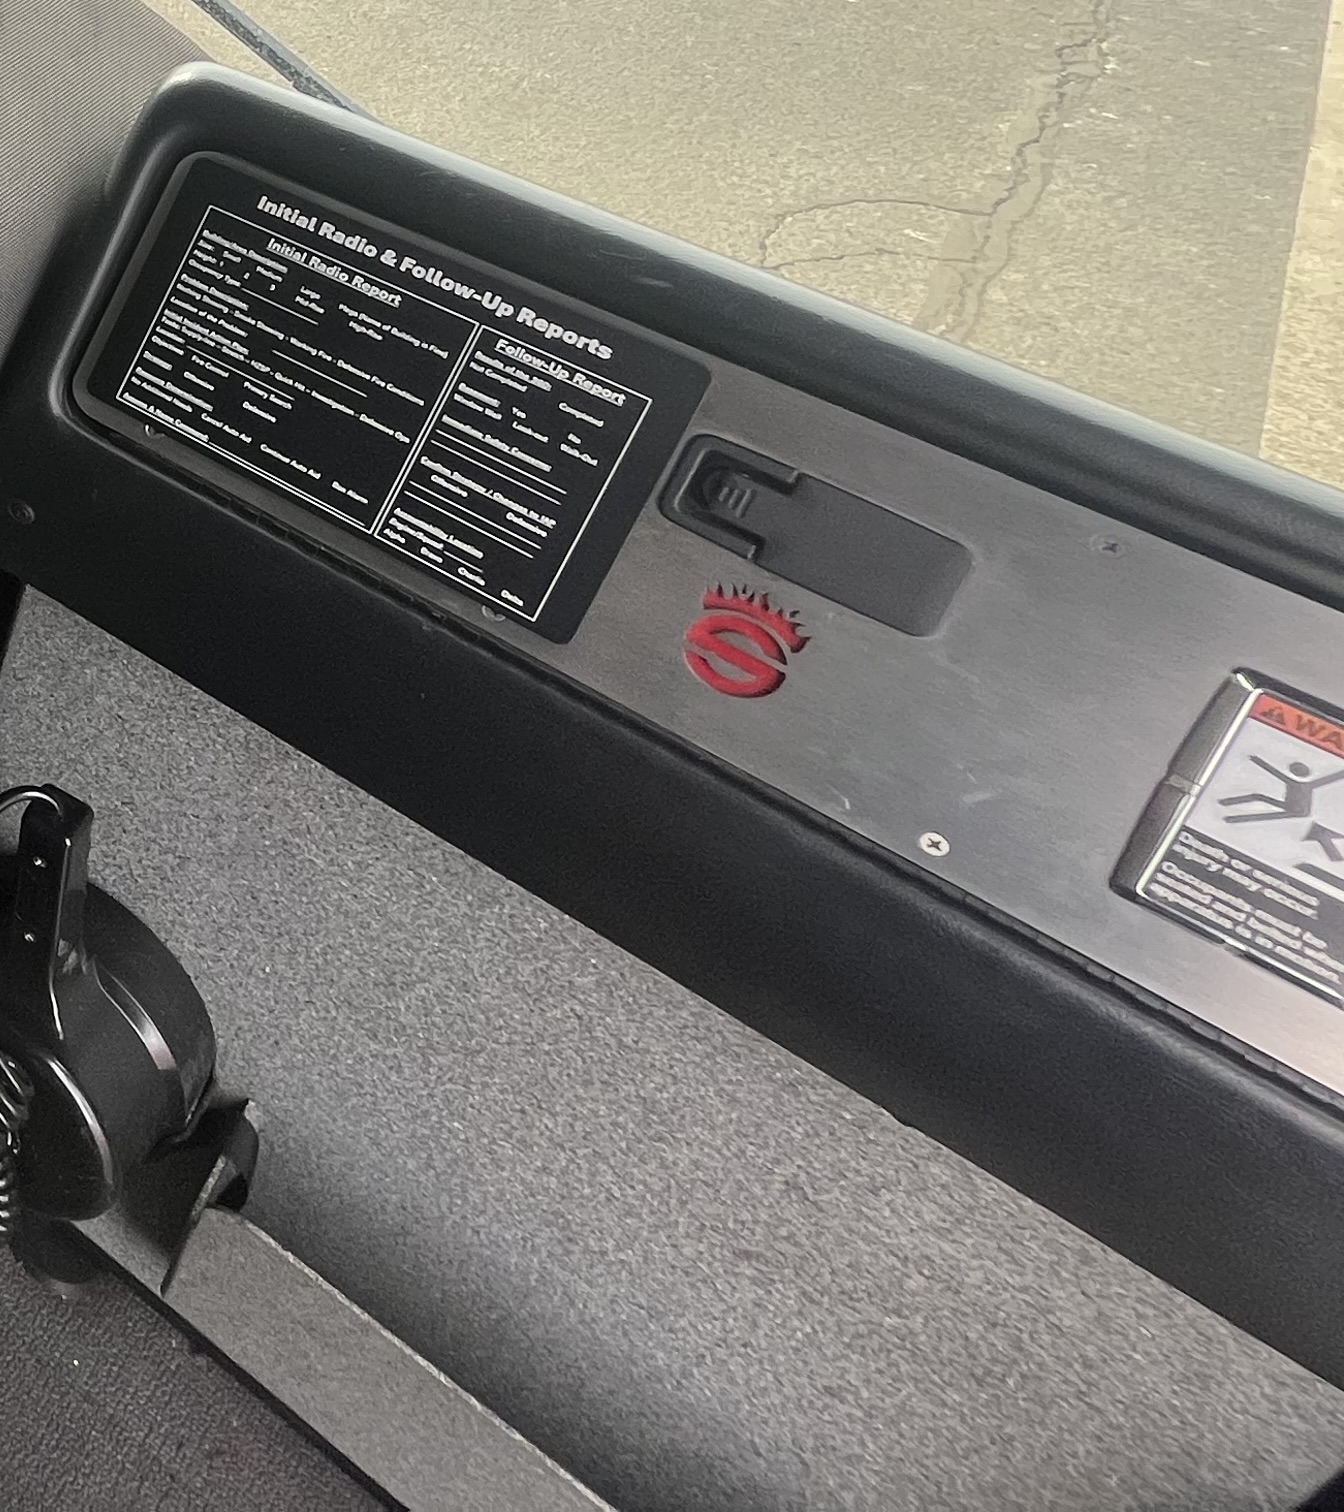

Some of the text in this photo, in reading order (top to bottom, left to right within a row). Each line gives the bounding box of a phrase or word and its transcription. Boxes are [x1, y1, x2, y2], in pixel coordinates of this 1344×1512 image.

[257, 196, 613, 359] Initial Radio & Follow-Up Reports
[267, 238, 402, 308] Initial Radio Report
[494, 339, 626, 406] Follow-Up Report
